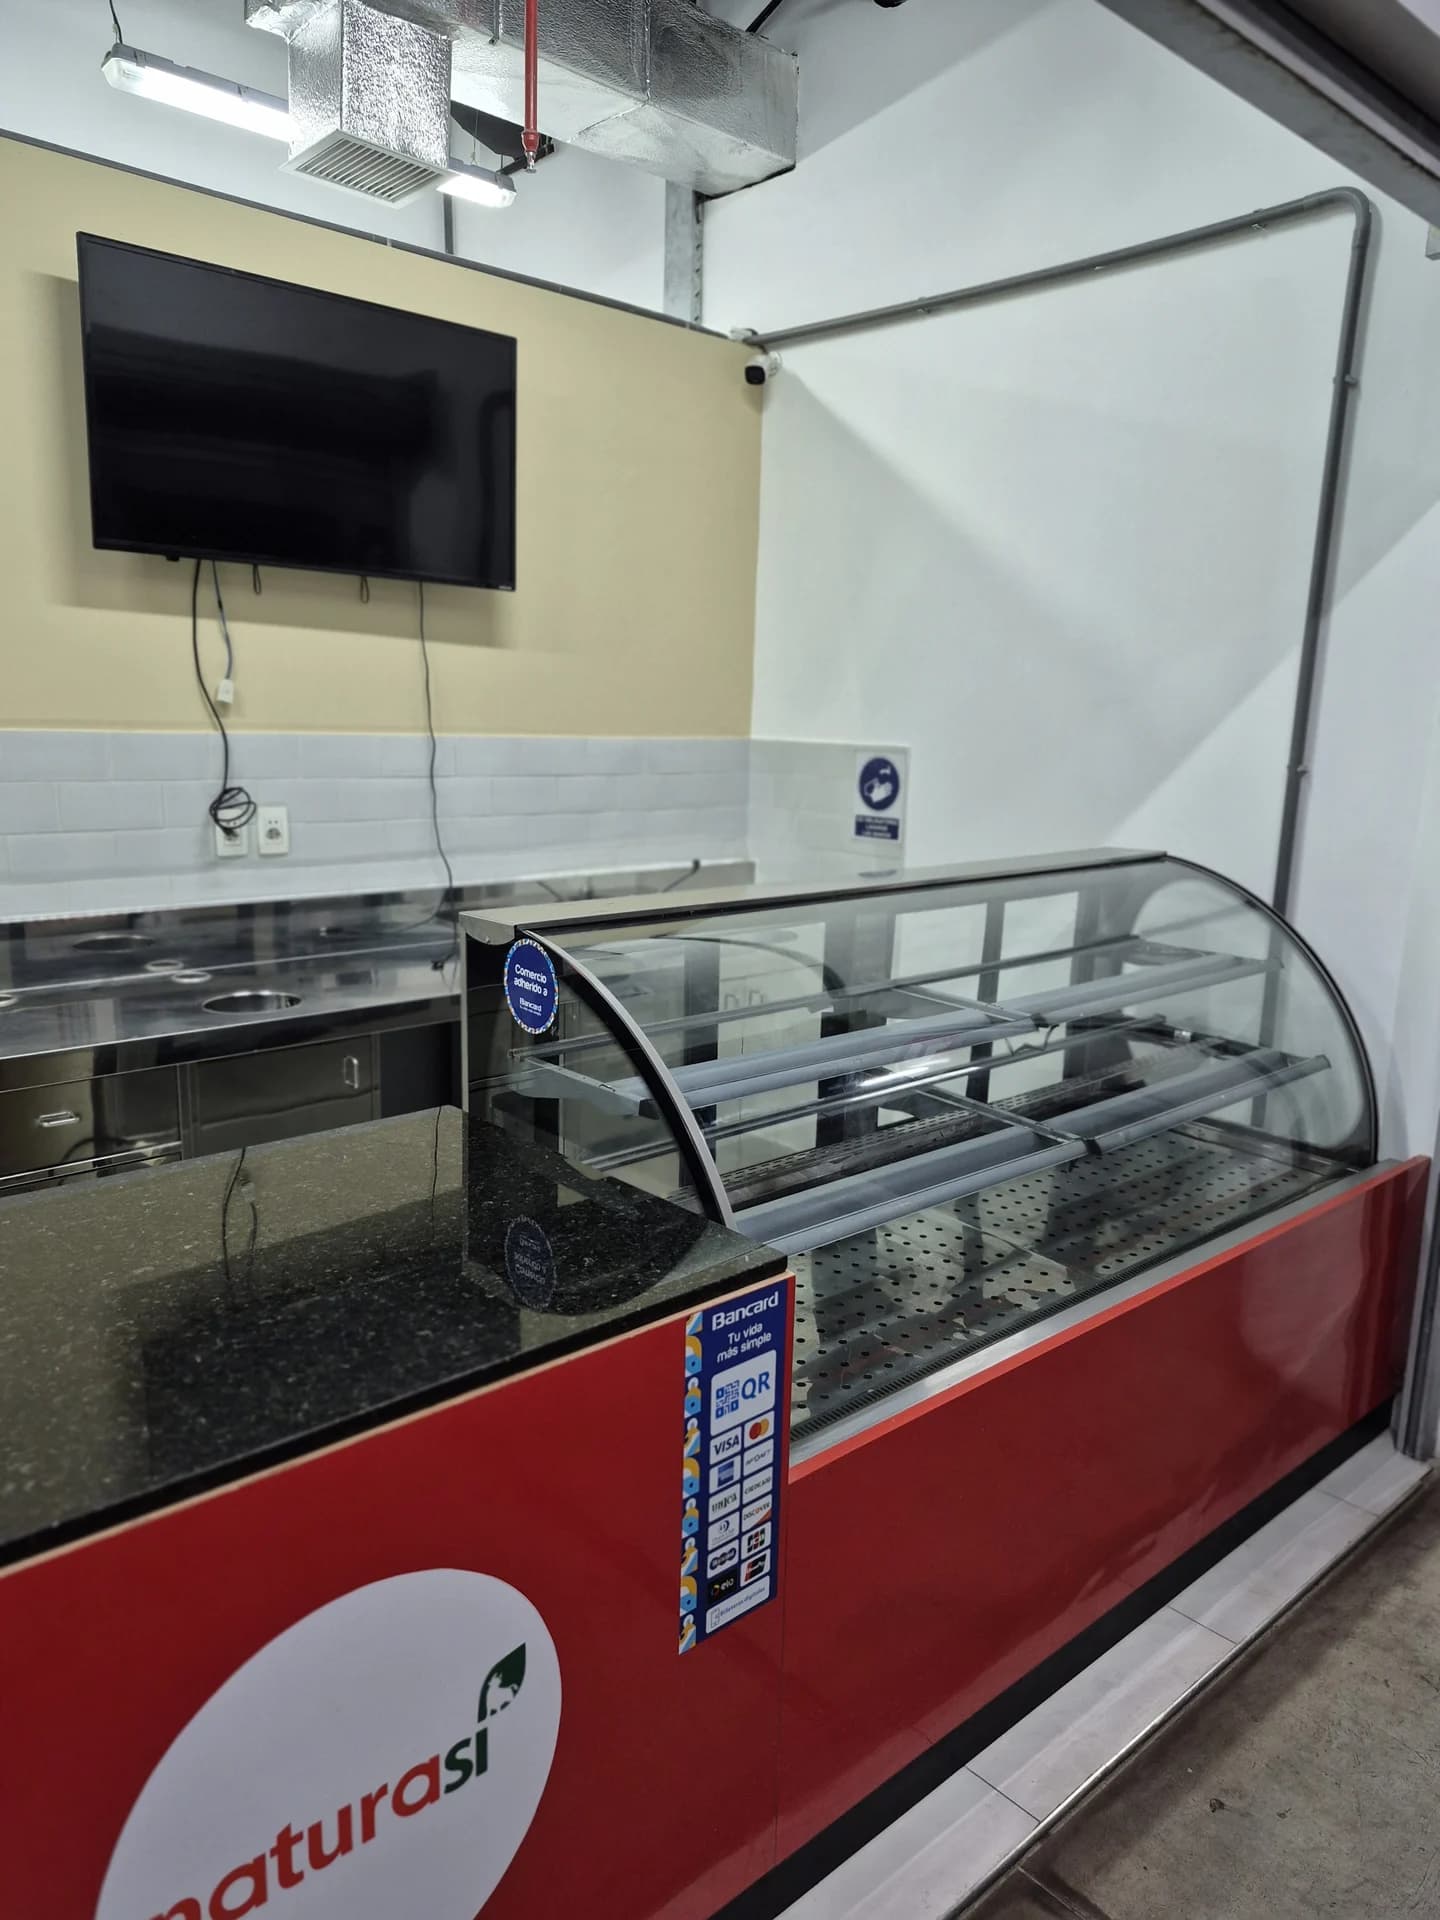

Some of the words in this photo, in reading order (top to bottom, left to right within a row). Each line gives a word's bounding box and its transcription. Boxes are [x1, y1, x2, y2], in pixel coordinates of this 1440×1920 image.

[514, 964, 547, 984] Comercio
[513, 977, 543, 994] adherido
[543, 988, 548, 997] a
[711, 1290, 779, 1331] Bancard
[728, 1331, 741, 1345] Tu
[743, 1322, 763, 1338] vida
[740, 1331, 772, 1354] simple
[741, 1371, 771, 1400] QR
[713, 1434, 740, 1456] VISA
